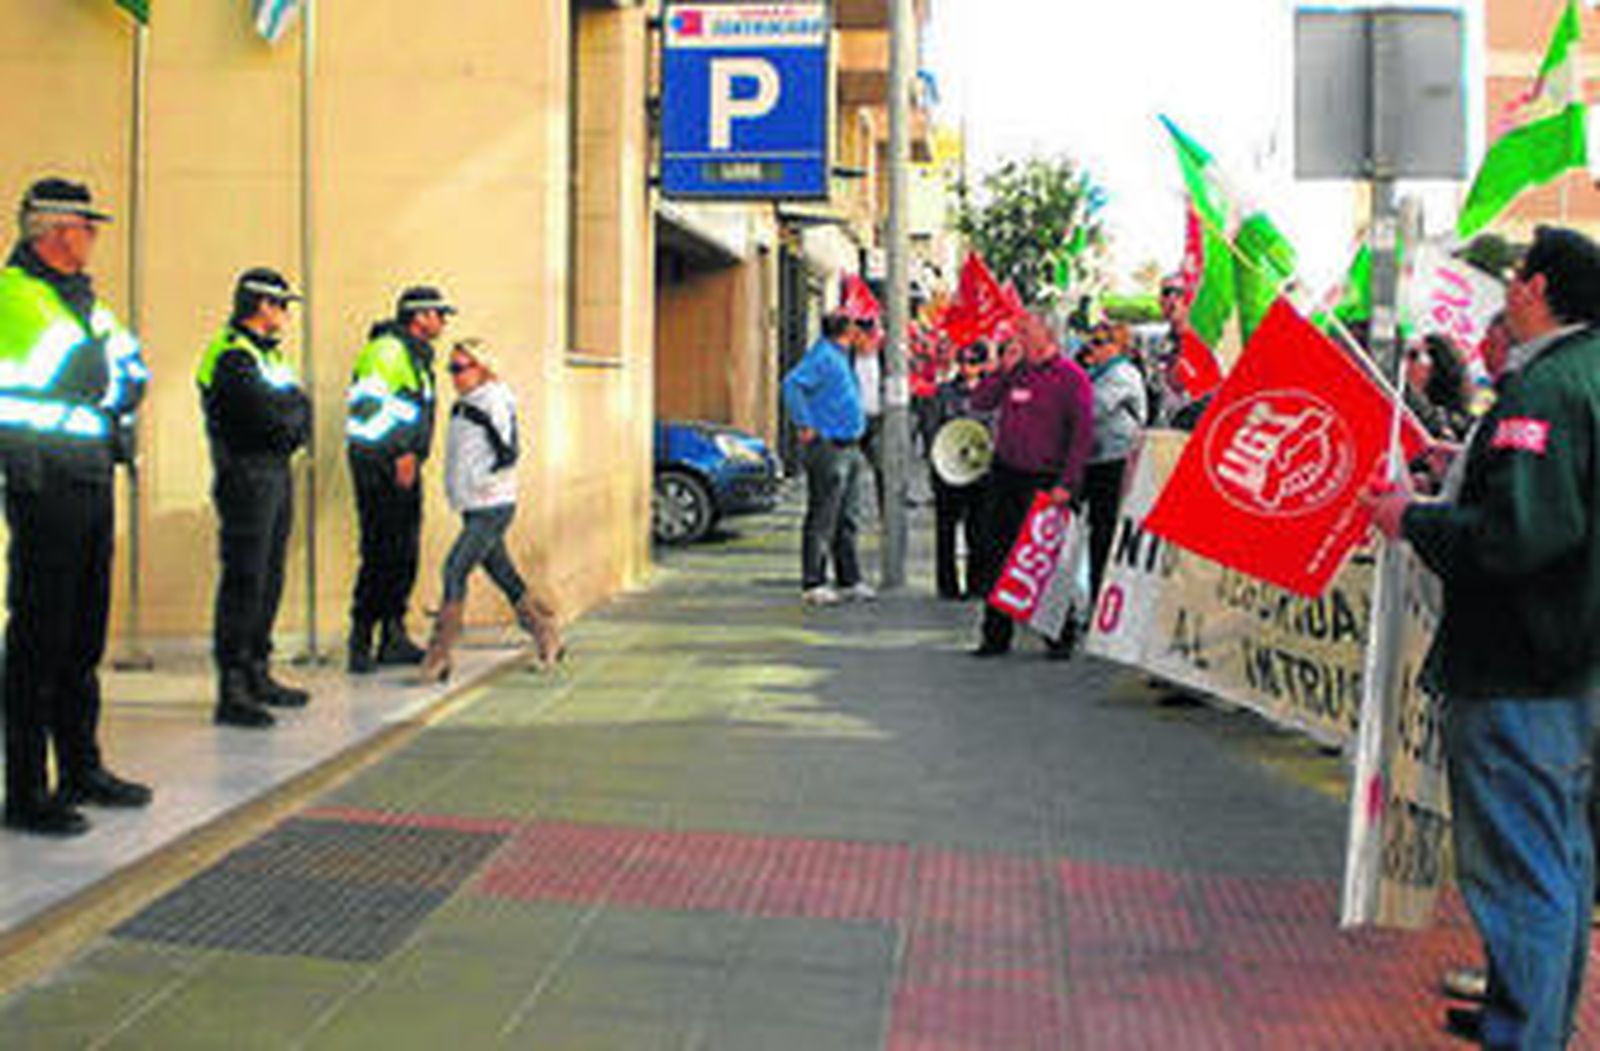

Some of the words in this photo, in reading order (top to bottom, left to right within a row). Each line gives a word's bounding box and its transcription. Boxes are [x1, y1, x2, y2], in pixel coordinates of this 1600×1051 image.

[711, 57, 780, 149] P
[1217, 401, 1300, 492] UGT
[998, 506, 1064, 610] USO
